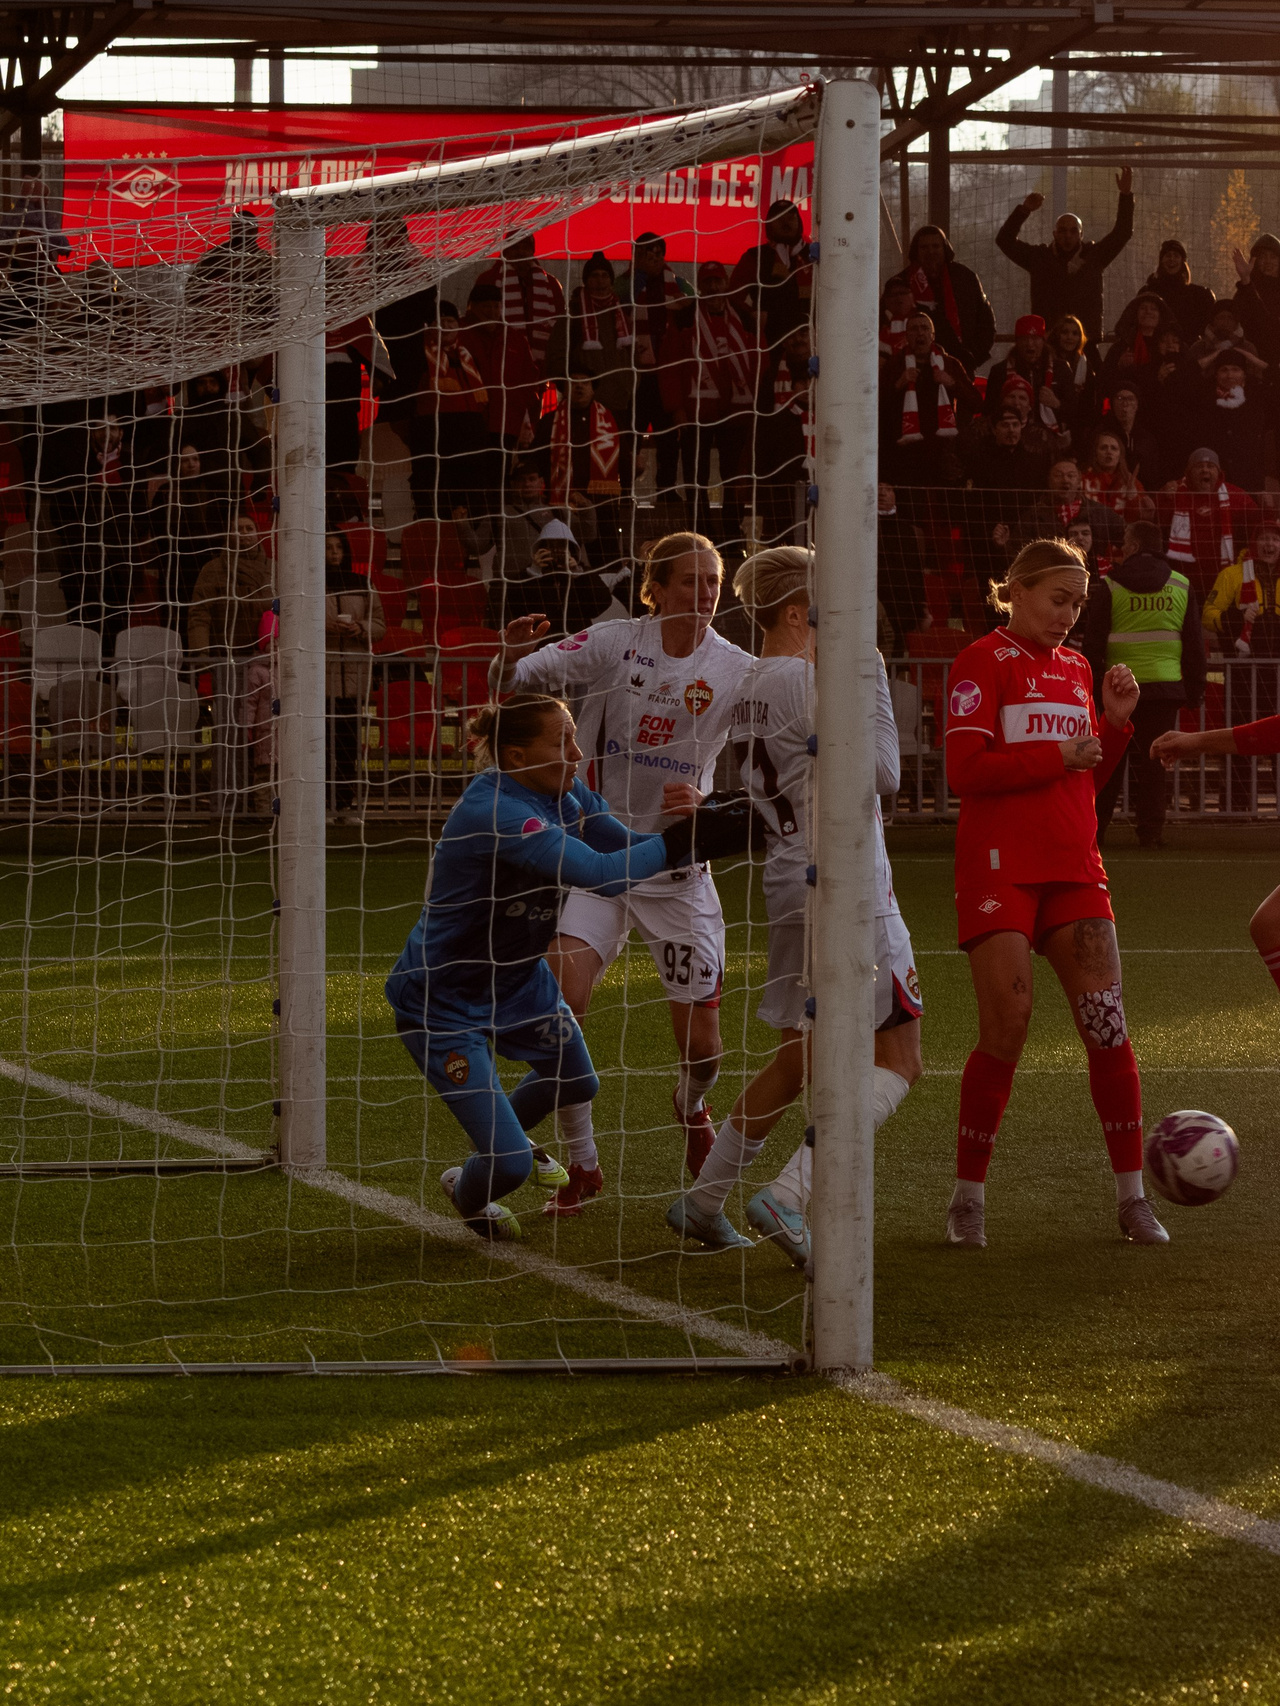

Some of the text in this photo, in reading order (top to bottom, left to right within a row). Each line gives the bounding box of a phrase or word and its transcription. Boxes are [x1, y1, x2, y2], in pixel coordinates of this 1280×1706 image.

[710, 163, 761, 208] БЕЗ
[769, 165, 813, 211] МА
[1129, 596, 1174, 612] D1102
[647, 693, 681, 707] РТА-АГРО
[639, 714, 676, 733] FON
[637, 729, 674, 747] BET
[664, 942, 696, 985] 93
[446, 1059, 469, 1074] ЦСКА
